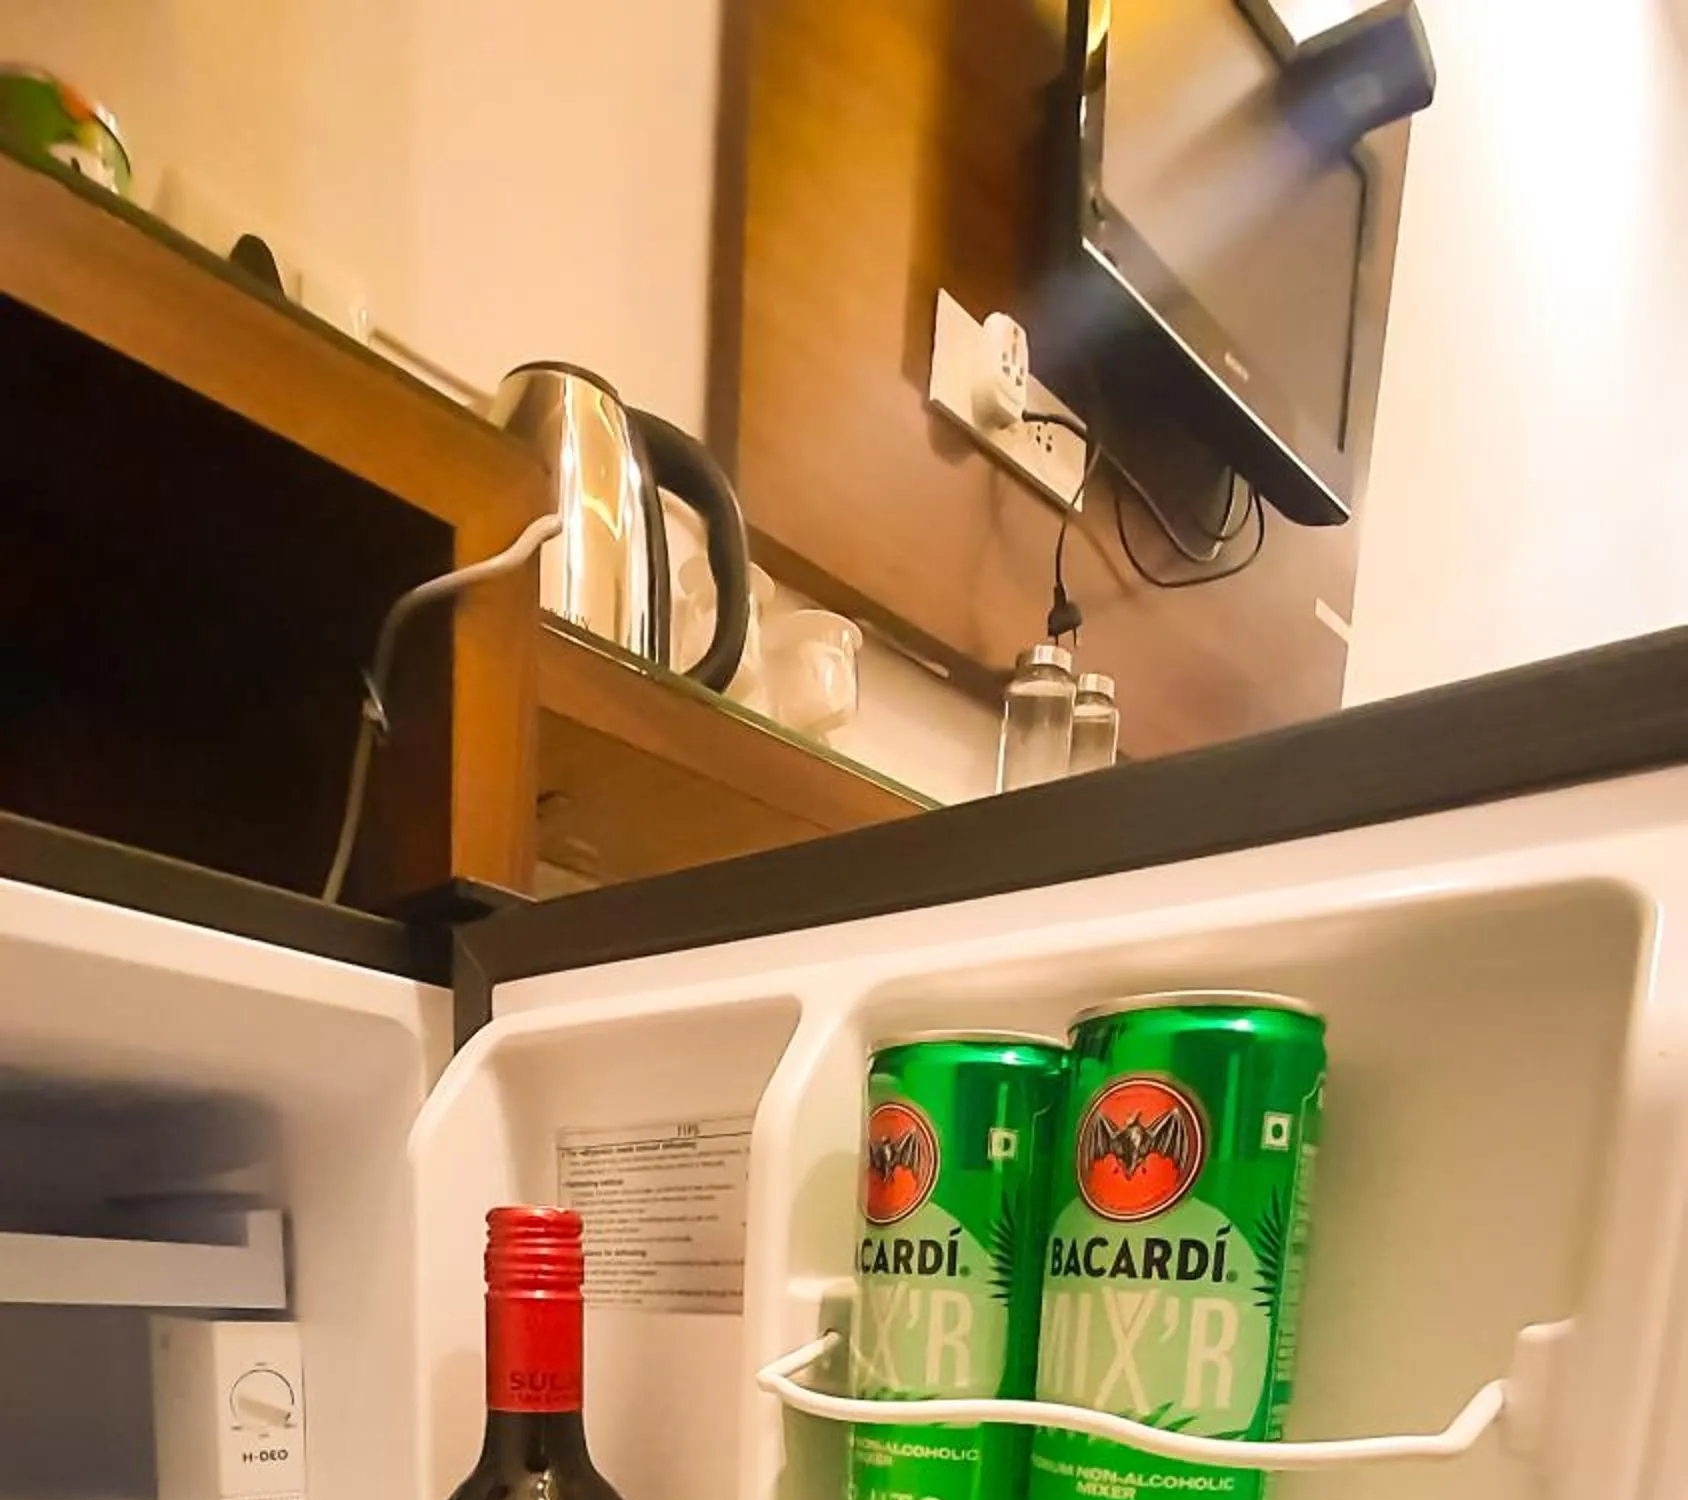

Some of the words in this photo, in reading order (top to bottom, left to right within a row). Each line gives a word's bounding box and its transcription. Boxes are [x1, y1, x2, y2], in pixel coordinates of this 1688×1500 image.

[855, 1227, 962, 1277] CARDÍ
[1050, 1224, 1232, 1282] BACARDÍ
[859, 1280, 974, 1390] X'R
[1075, 1465, 1235, 1492] NON-ALCOHOLIC
